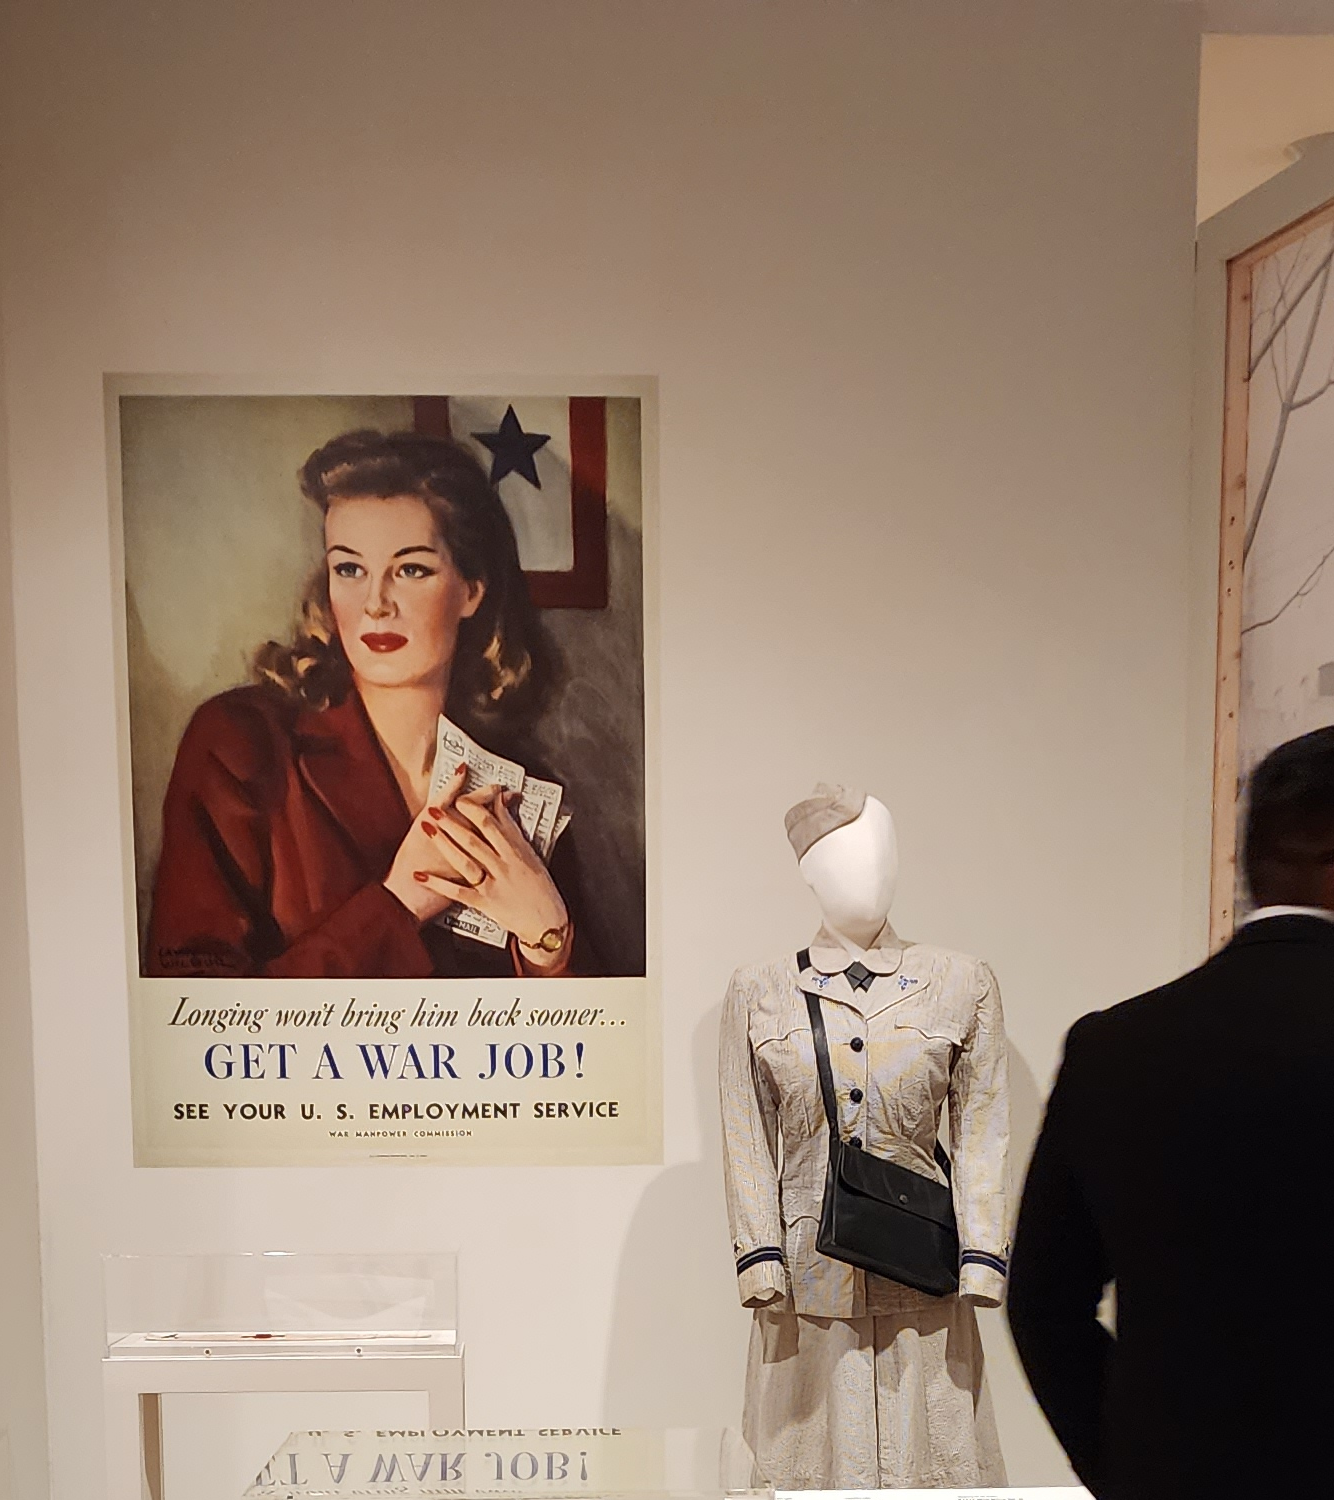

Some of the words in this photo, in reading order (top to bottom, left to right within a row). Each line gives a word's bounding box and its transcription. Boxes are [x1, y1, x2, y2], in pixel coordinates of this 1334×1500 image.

[167, 996, 269, 1034] Longing
[276, 1003, 336, 1027] won't
[340, 998, 406, 1034] bring
[410, 998, 459, 1027] him
[467, 998, 521, 1027] back
[525, 1006, 626, 1027] sooner...
[204, 1043, 298, 1080] GET
[312, 1043, 344, 1080] A
[355, 1043, 462, 1080] WAR
[478, 1042, 584, 1080] JOB!
[173, 1103, 210, 1120] SEE
[223, 1103, 287, 1120] YOUR
[300, 1103, 322, 1120] U.
[336, 1103, 355, 1120] S.
[369, 1103, 521, 1120] EMPLOYMENT
[533, 1101, 620, 1119] SERVICE
[329, 1130, 349, 1138] WAR
[356, 1130, 407, 1138] MANPOWER
[413, 1129, 472, 1137] COMMISSION
